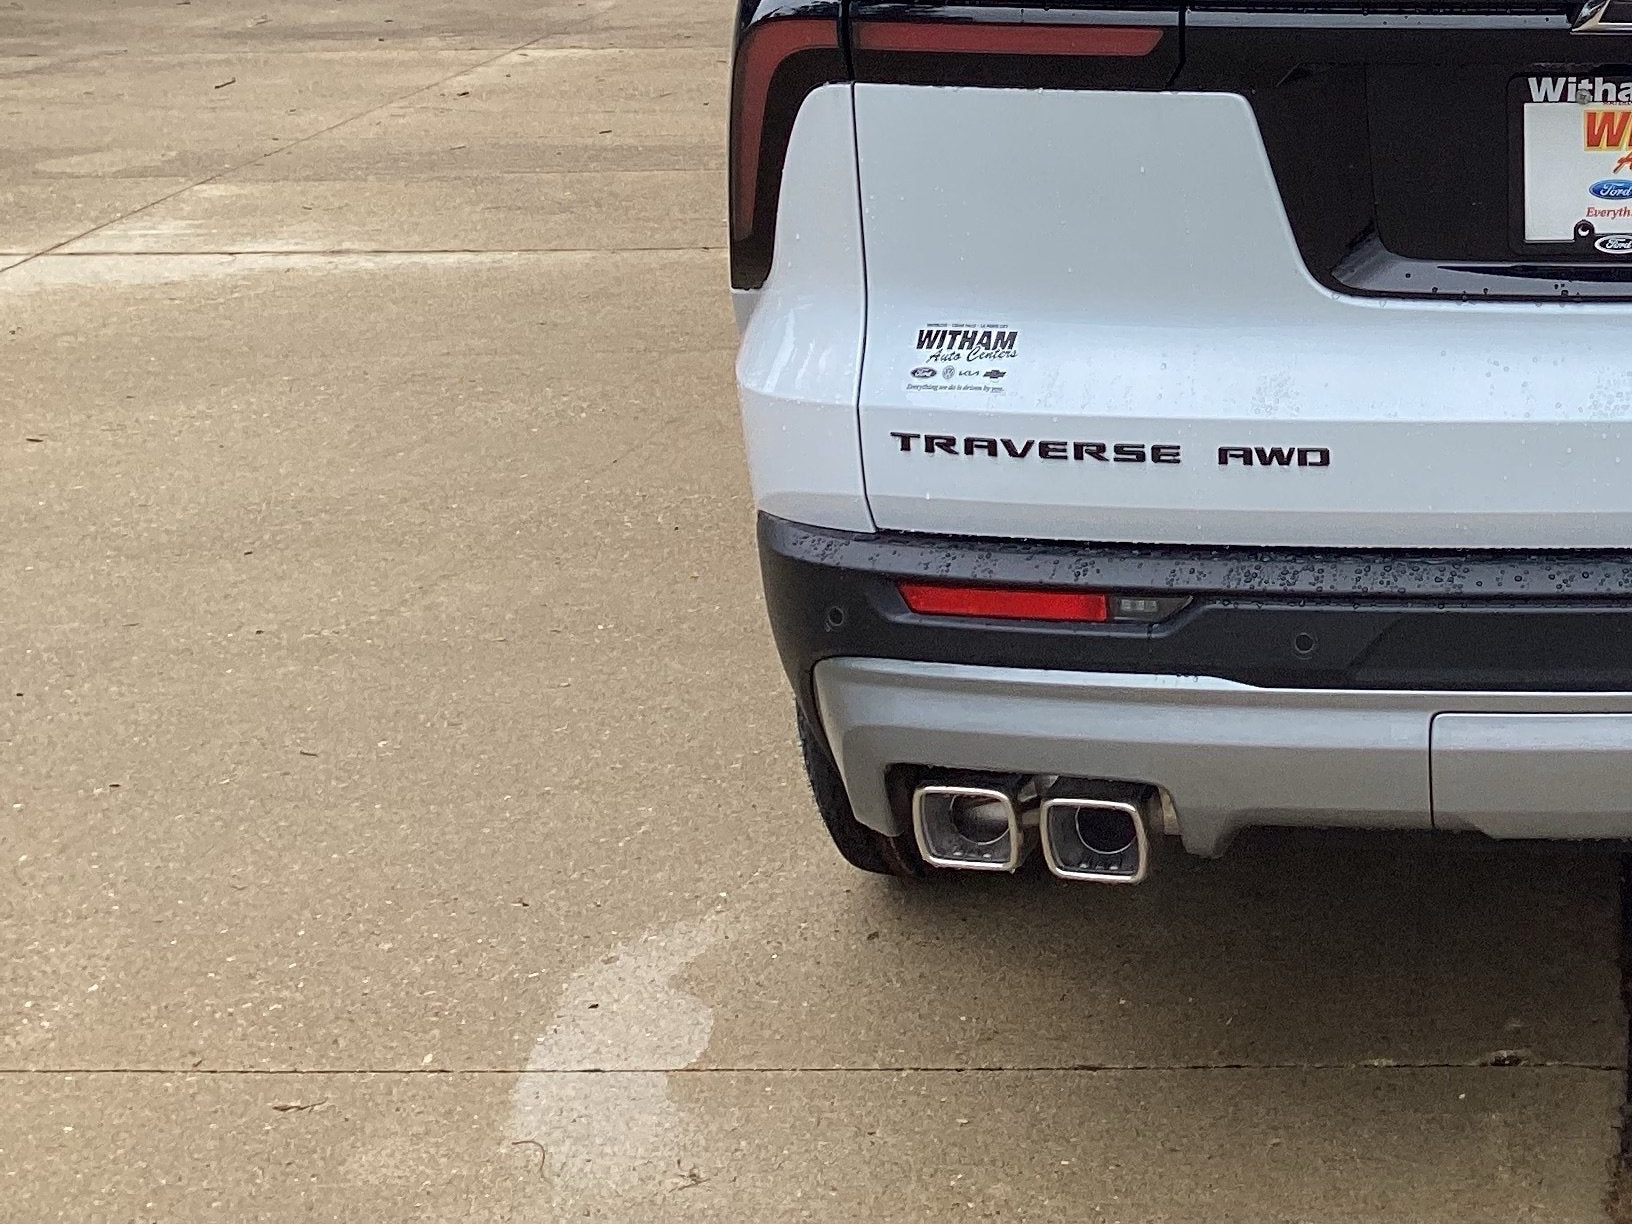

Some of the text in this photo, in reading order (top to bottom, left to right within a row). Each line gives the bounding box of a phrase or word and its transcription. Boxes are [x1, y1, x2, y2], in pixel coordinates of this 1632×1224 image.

[916, 329, 1018, 351] WITHAM
[926, 345, 1018, 363] Auto Centers
[890, 431, 1331, 467] TRAVERSE AWD
